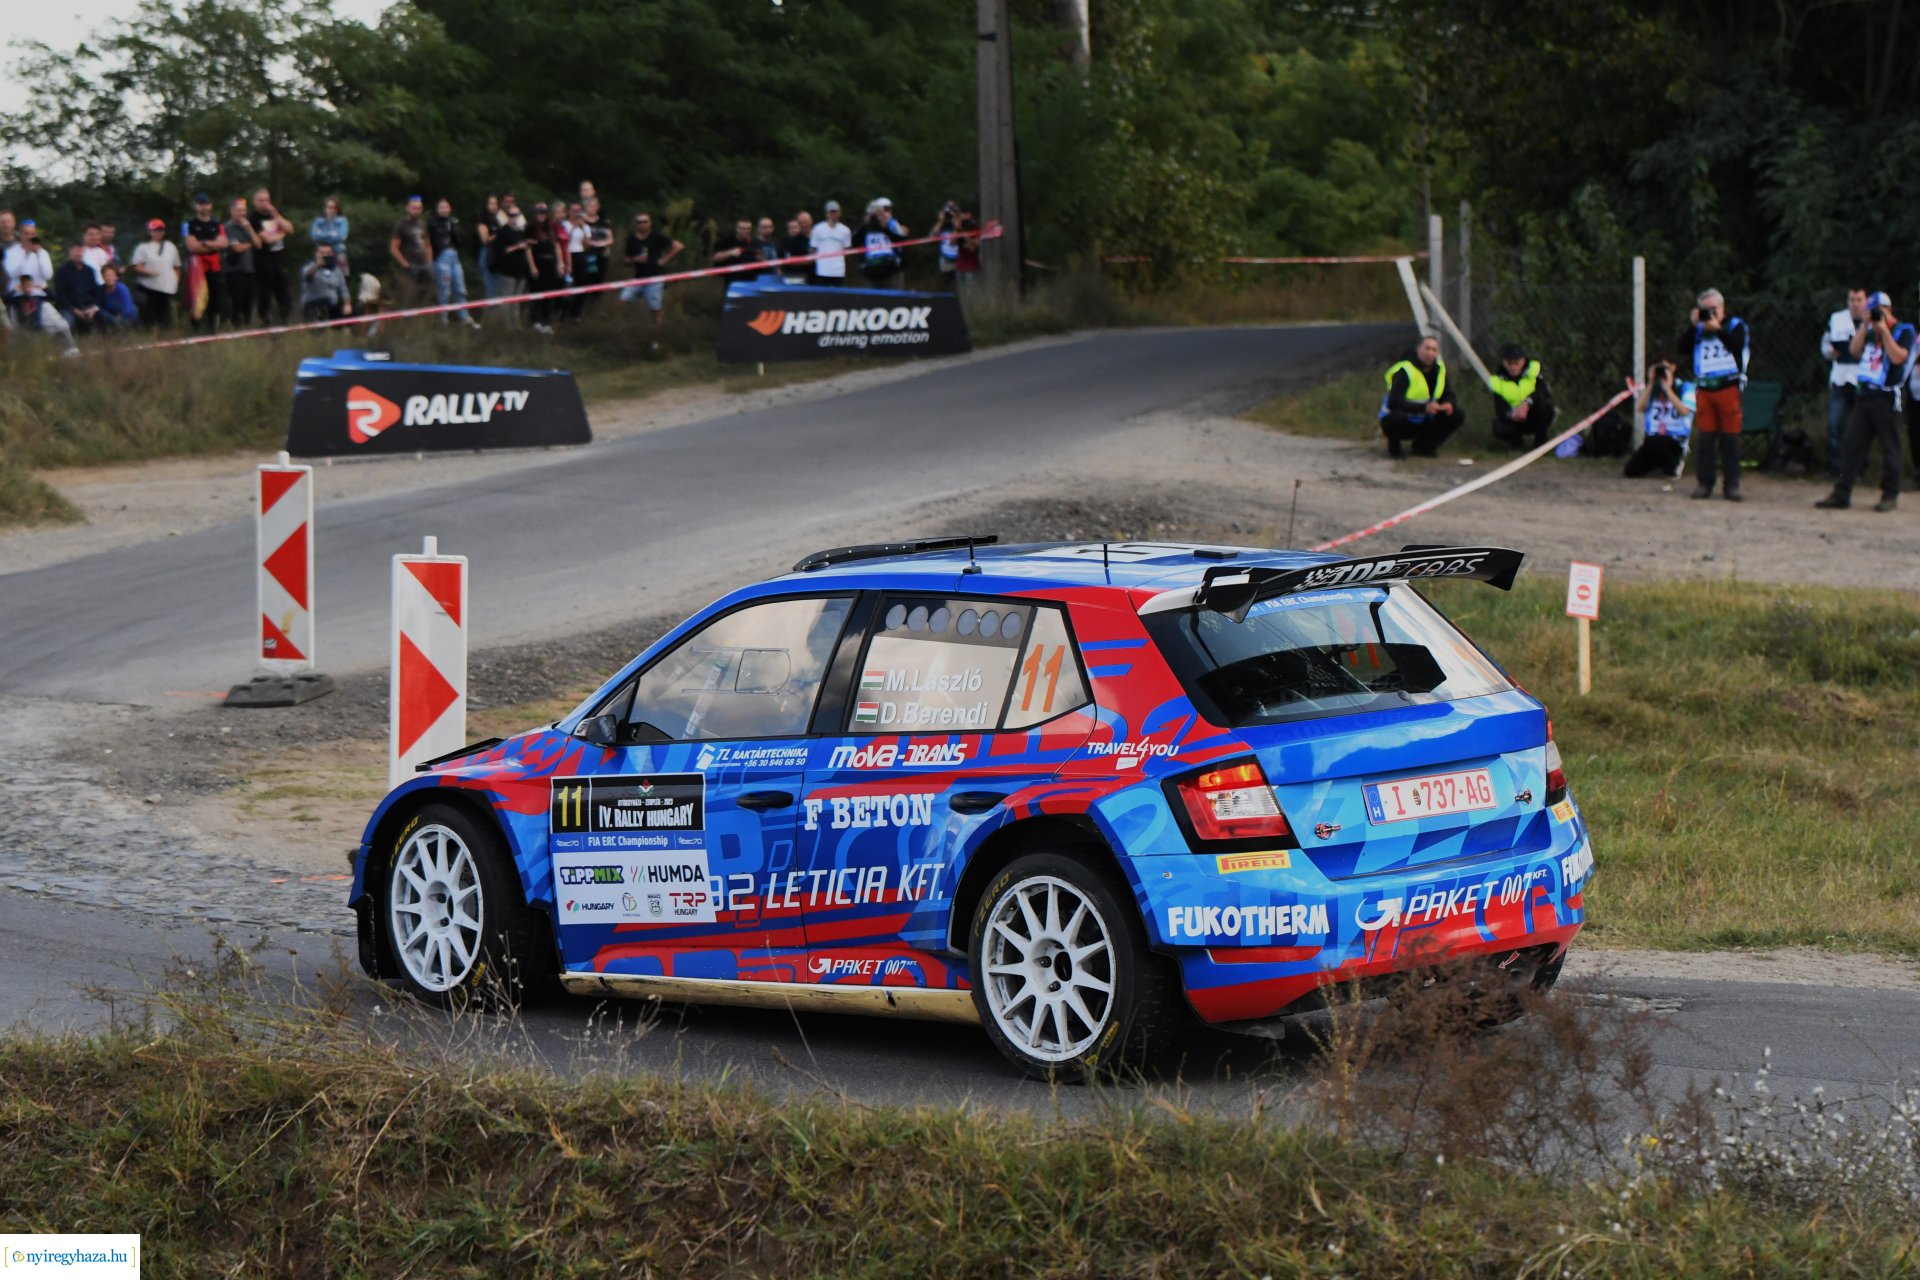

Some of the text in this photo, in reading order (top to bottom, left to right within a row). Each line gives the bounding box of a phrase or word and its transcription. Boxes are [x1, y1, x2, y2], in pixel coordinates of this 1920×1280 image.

[818, 331, 929, 348] driving emotion
[1328, 558, 1484, 586] TOP CARS
[1298, 592, 1354, 603] Championship
[1021, 643, 1065, 712] 11
[880, 701, 989, 725] D.Berendi
[717, 747, 808, 760] TL RAKTÁRTECHNIKA
[1087, 736, 1180, 762] TRAVEL4YOU
[758, 759, 768, 767] 30
[785, 758, 794, 766] 68
[557, 785, 582, 827] 11
[600, 803, 694, 828] IV. RALLY HUNGARY
[804, 793, 935, 831] F BETON
[1373, 807, 1382, 818] H
[588, 836, 601, 847] FIA
[602, 836, 616, 847] ERC
[618, 835, 669, 848] Championship
[1221, 852, 1286, 872] PIRELLI
[649, 864, 705, 882] HUMDA
[766, 866, 888, 909] LETICIA
[896, 863, 945, 902] KFT.
[582, 903, 614, 912] HUNGARY
[669, 892, 707, 907] TRP
[1404, 881, 1499, 925] PAKET
[1501, 872, 1532, 906] 007
[674, 908, 698, 916] HUNGARY
[1168, 904, 1330, 937] FUKOTHERM
[832, 960, 884, 974] PAKET
[885, 960, 906, 975] 007
